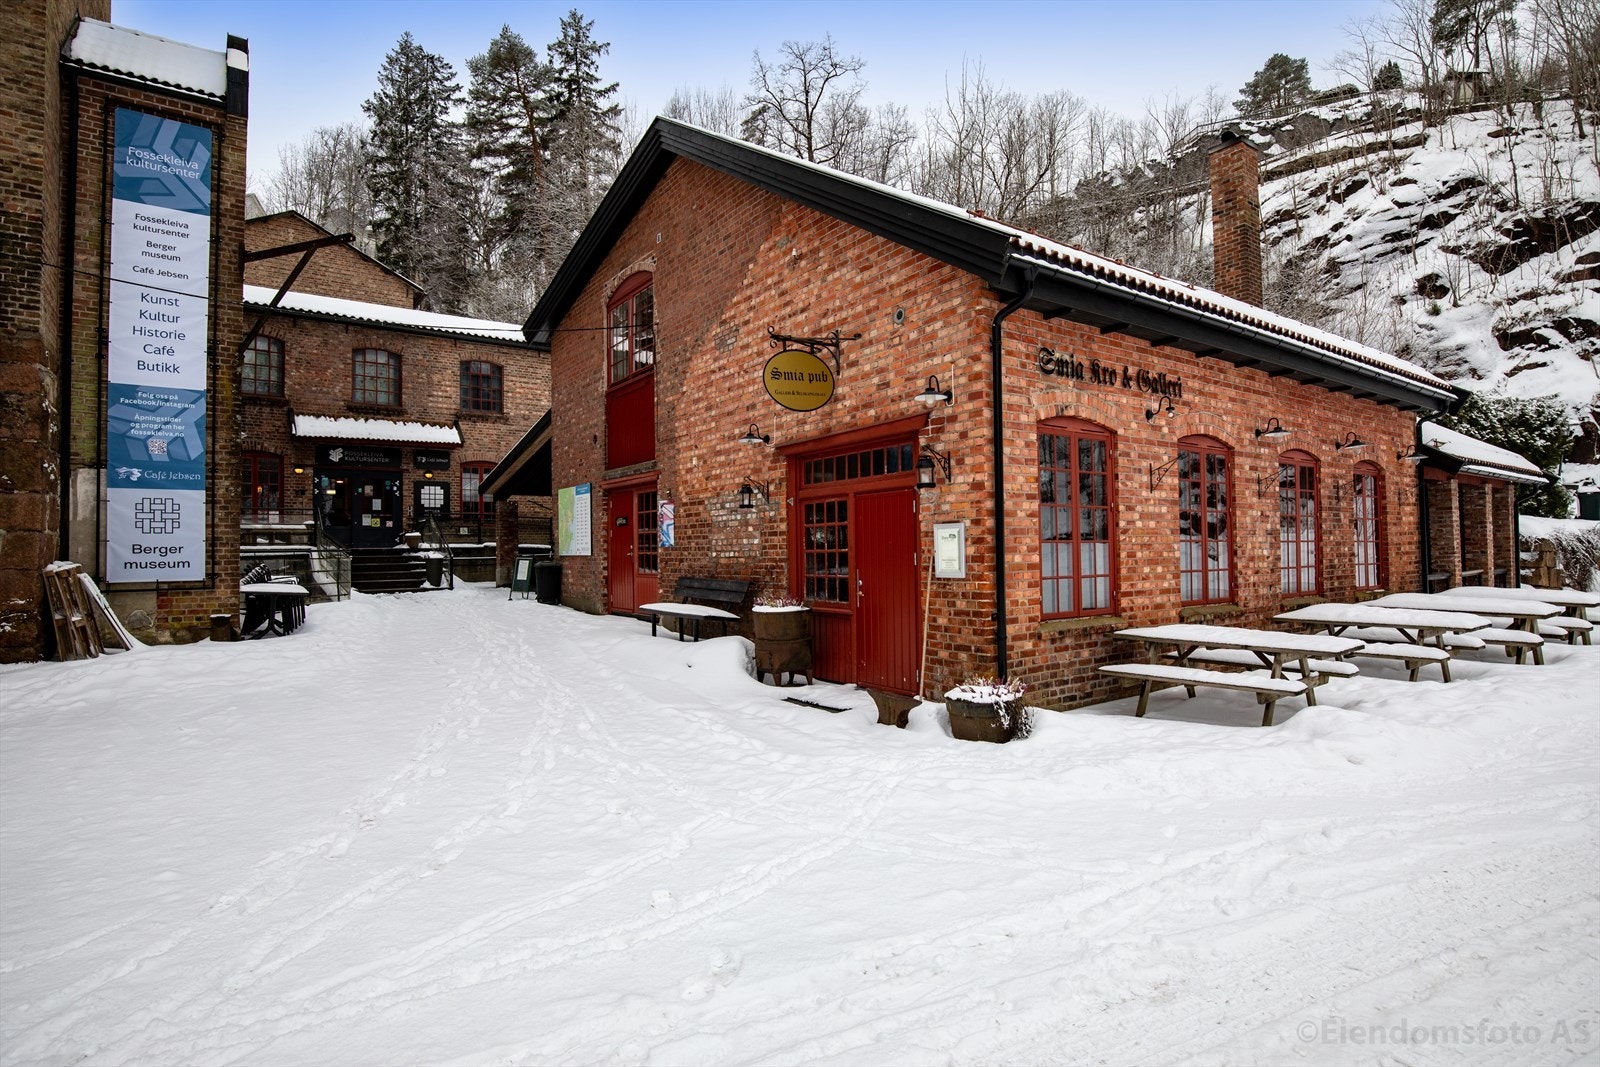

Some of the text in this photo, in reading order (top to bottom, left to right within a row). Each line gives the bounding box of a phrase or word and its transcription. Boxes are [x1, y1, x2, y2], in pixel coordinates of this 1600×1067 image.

[128, 146, 199, 170] Fossekleiva
[126, 156, 200, 180] kultursenter
[135, 213, 189, 229] Fossekleiva
[133, 223, 190, 239] kultursenter
[146, 240, 177, 252] Berger
[141, 250, 181, 262] museum
[132, 265, 189, 280] Café Jebsen
[140, 292, 180, 307] Kunst
[139, 309, 181, 324] Kultur
[132, 325, 186, 341] Historie
[143, 343, 175, 356] Café
[137, 360, 181, 374] Butikk
[1038, 347, 1183, 399] Smia Kro & Galleri
[770, 366, 828, 383] Smia pub
[120, 397, 196, 409] Facebook/Instagram
[169, 393, 179, 401] på
[134, 413, 182, 422] Åpningstider
[131, 429, 185, 437] fossekleiva.no
[344, 455, 389, 463] KULTURSENTER
[144, 469, 201, 480] Café Jebsen
[132, 544, 184, 557] Berger
[124, 560, 191, 570] museum
